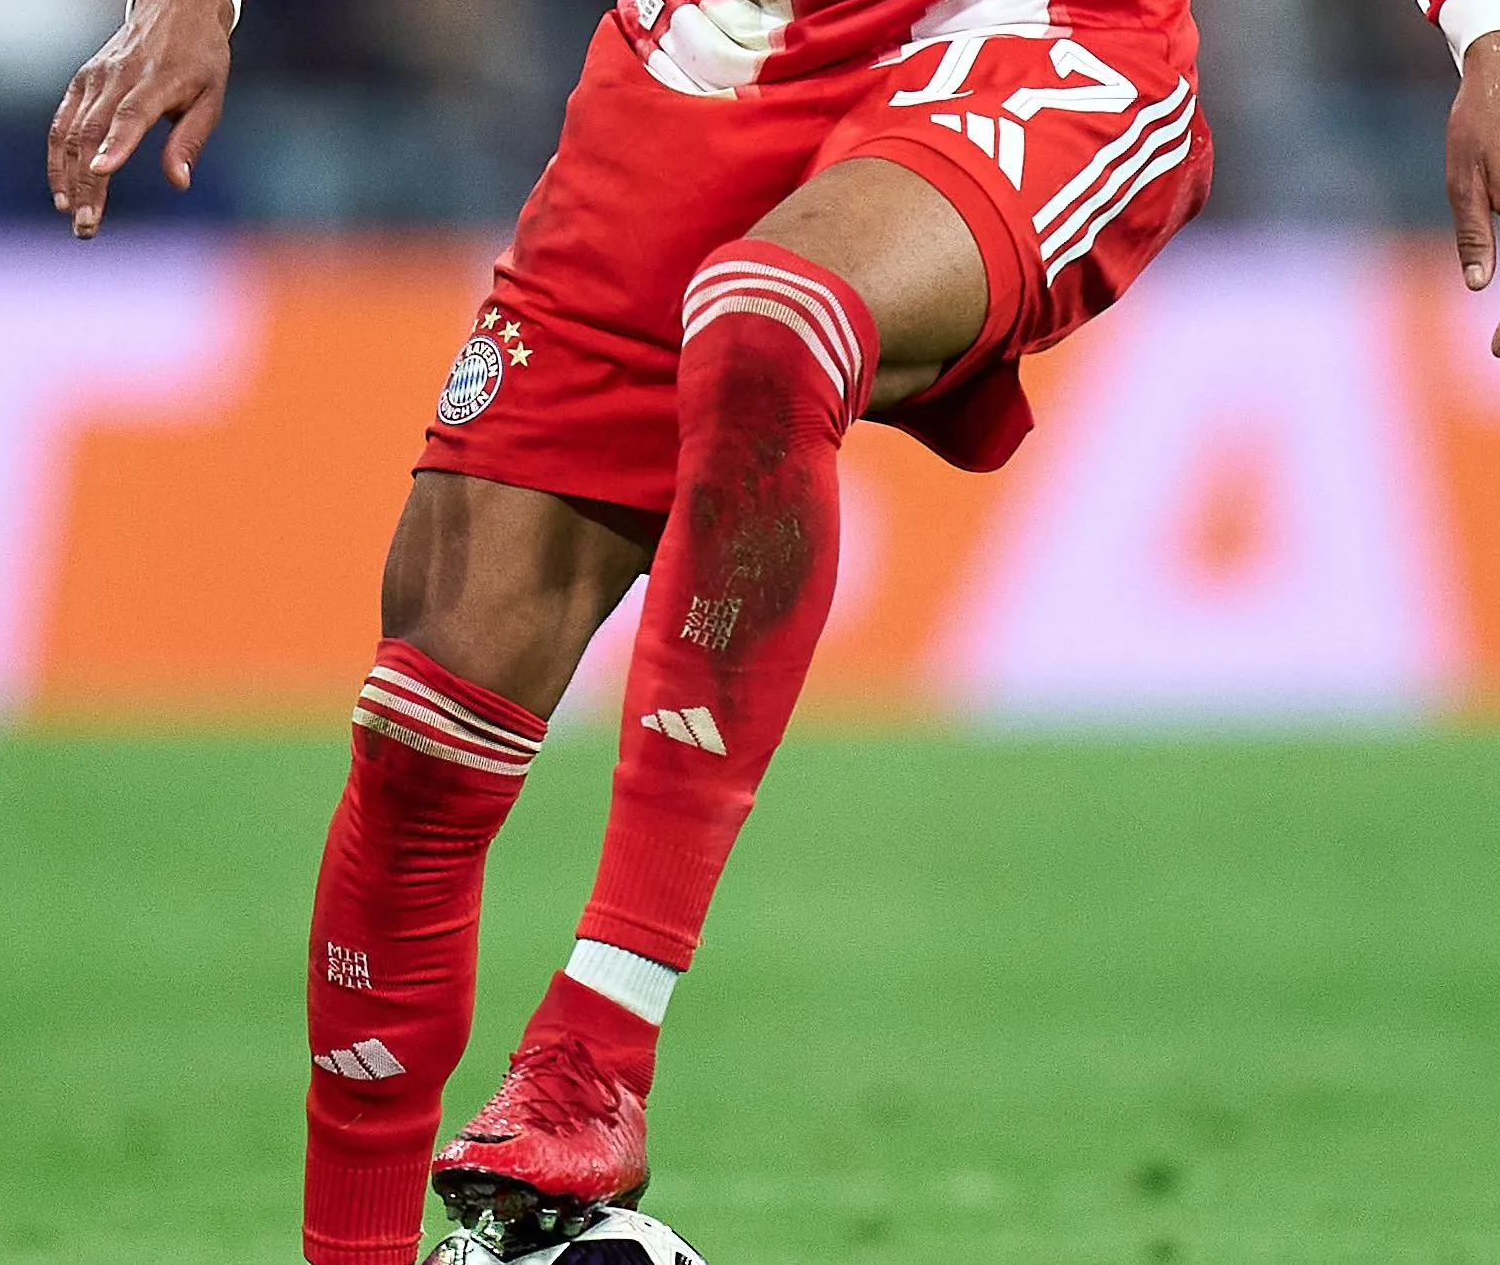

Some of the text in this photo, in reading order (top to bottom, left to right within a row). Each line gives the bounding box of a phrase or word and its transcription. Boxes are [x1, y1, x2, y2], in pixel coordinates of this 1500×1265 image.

[680, 625, 729, 651] MIA
[327, 941, 367, 963] MIA
[327, 957, 370, 978] SAN
[327, 969, 372, 990] MIA
